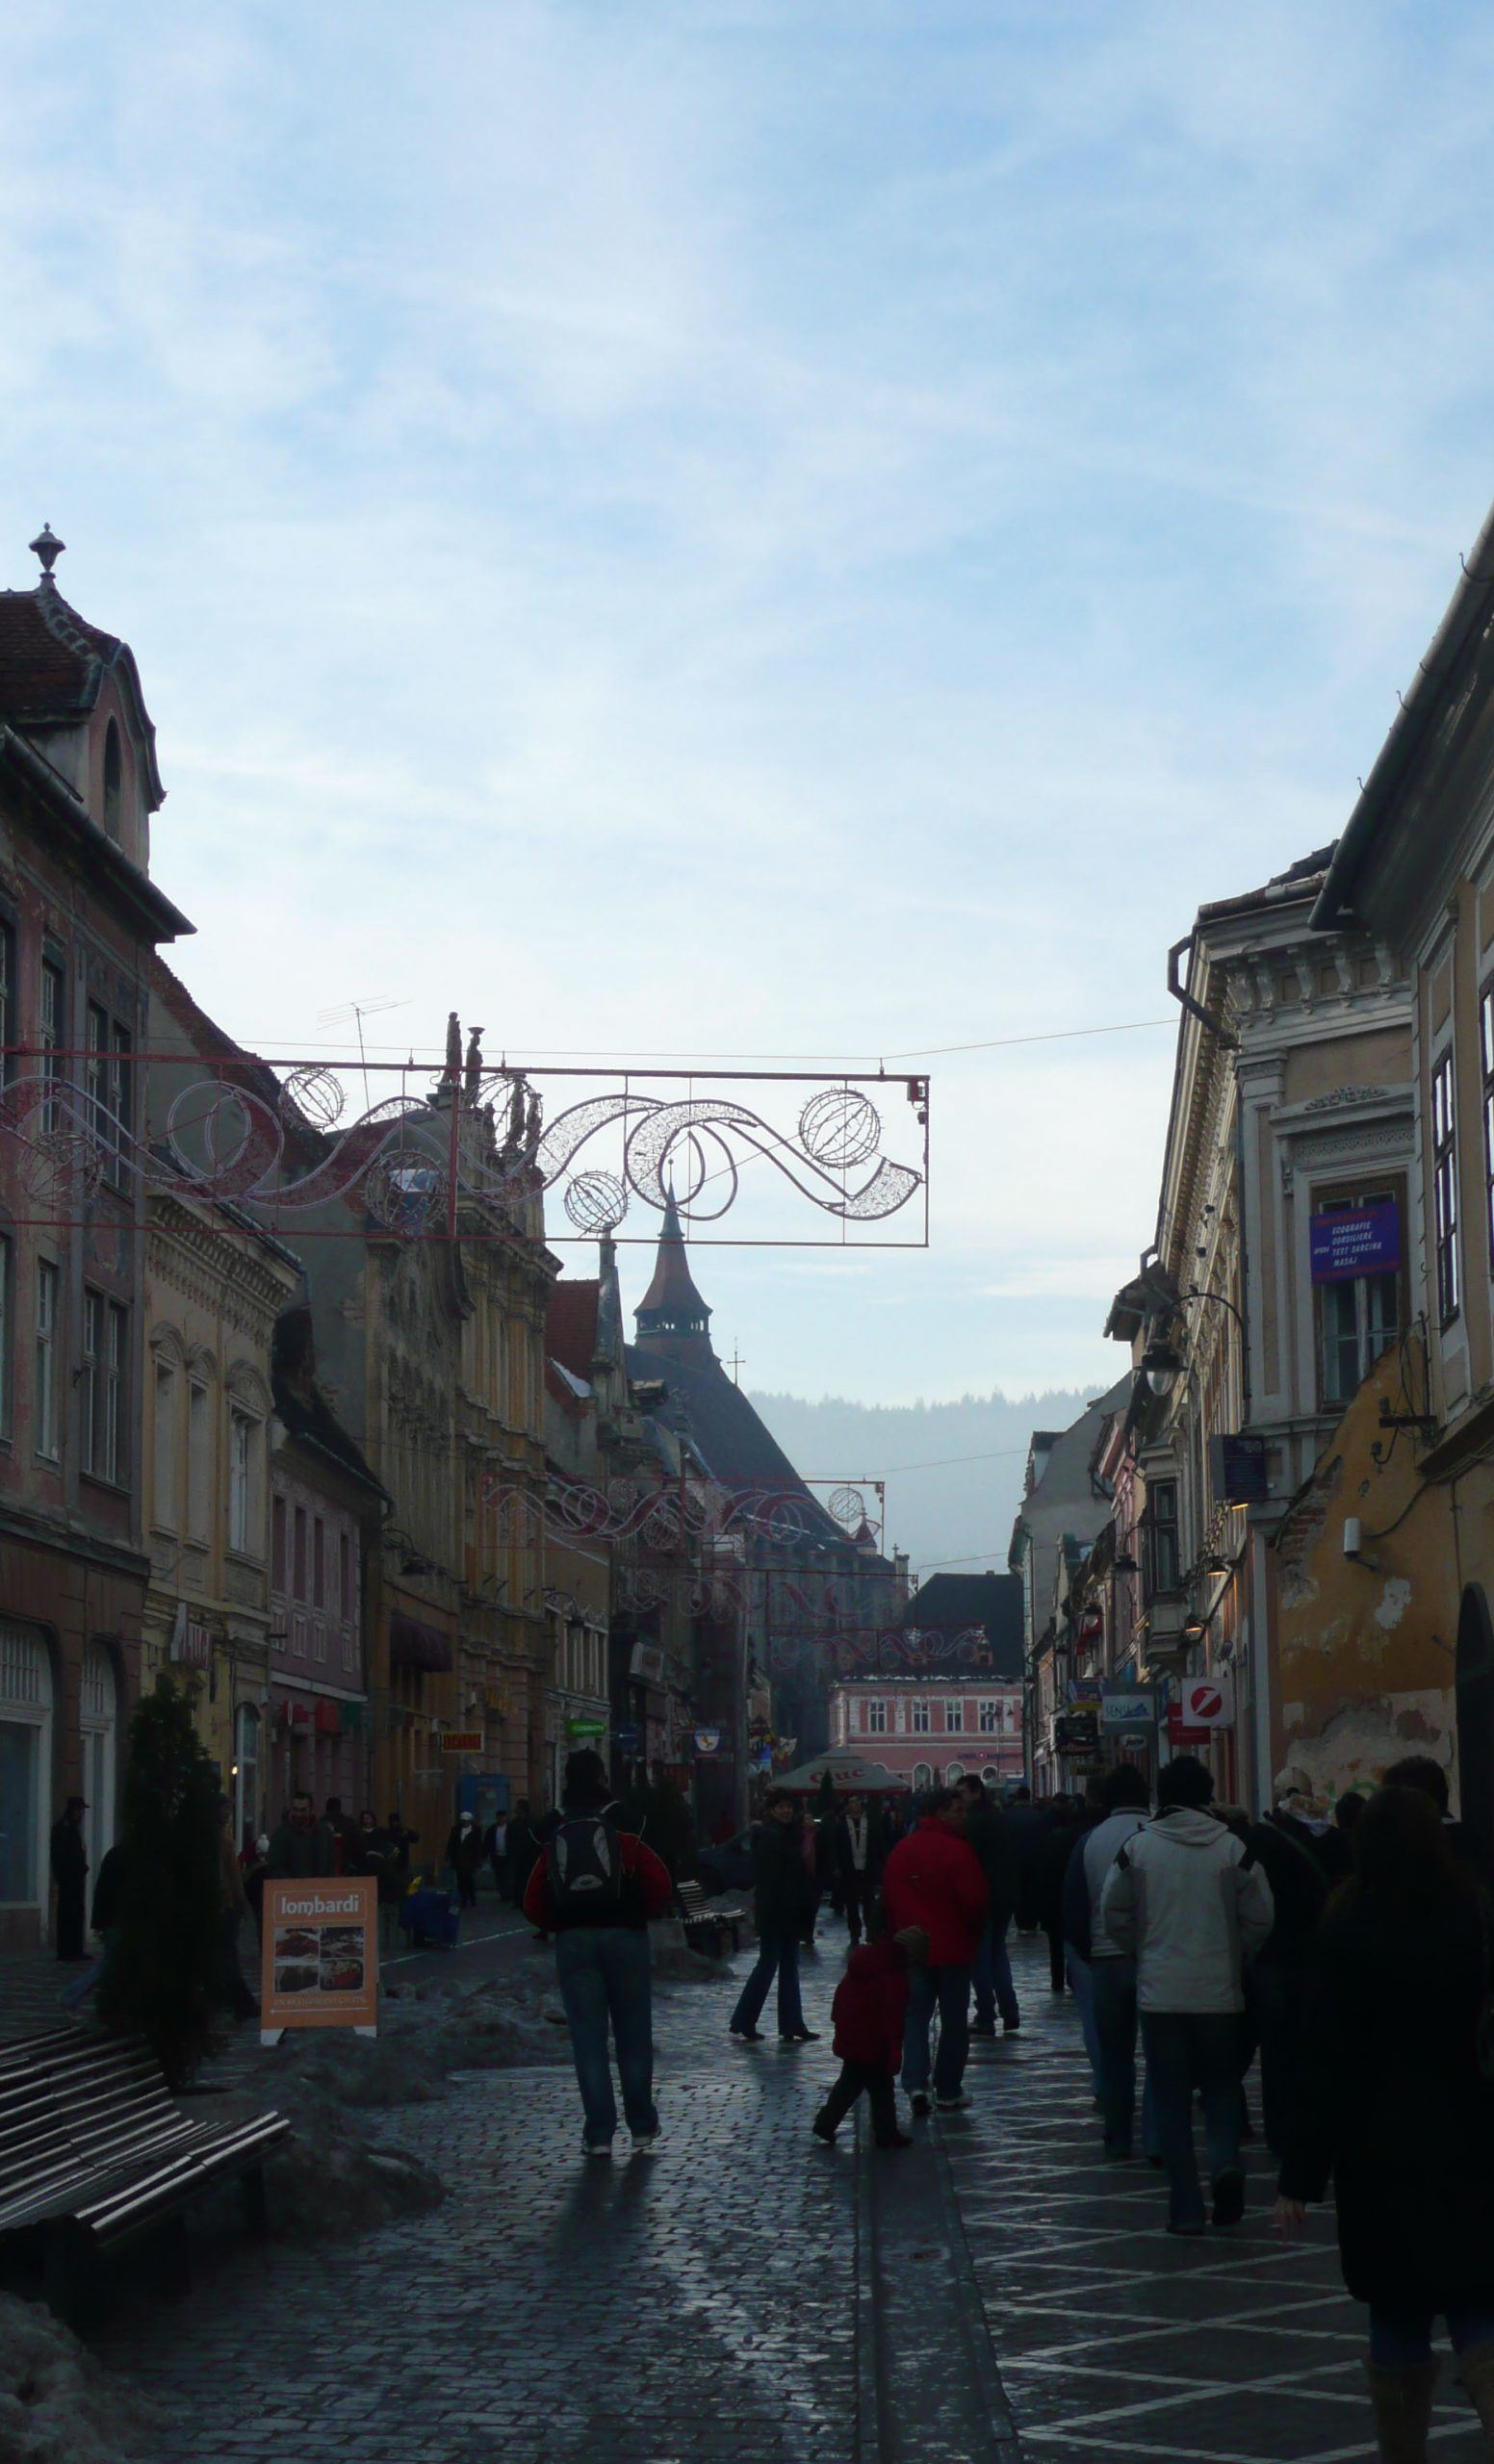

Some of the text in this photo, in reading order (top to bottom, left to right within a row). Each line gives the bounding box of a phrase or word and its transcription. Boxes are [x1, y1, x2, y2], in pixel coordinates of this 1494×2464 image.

[1332, 1242, 1382, 1256] TEST SARCINA
[1333, 1256, 1357, 1268] MASAJ
[281, 1894, 359, 1916] lombardi
